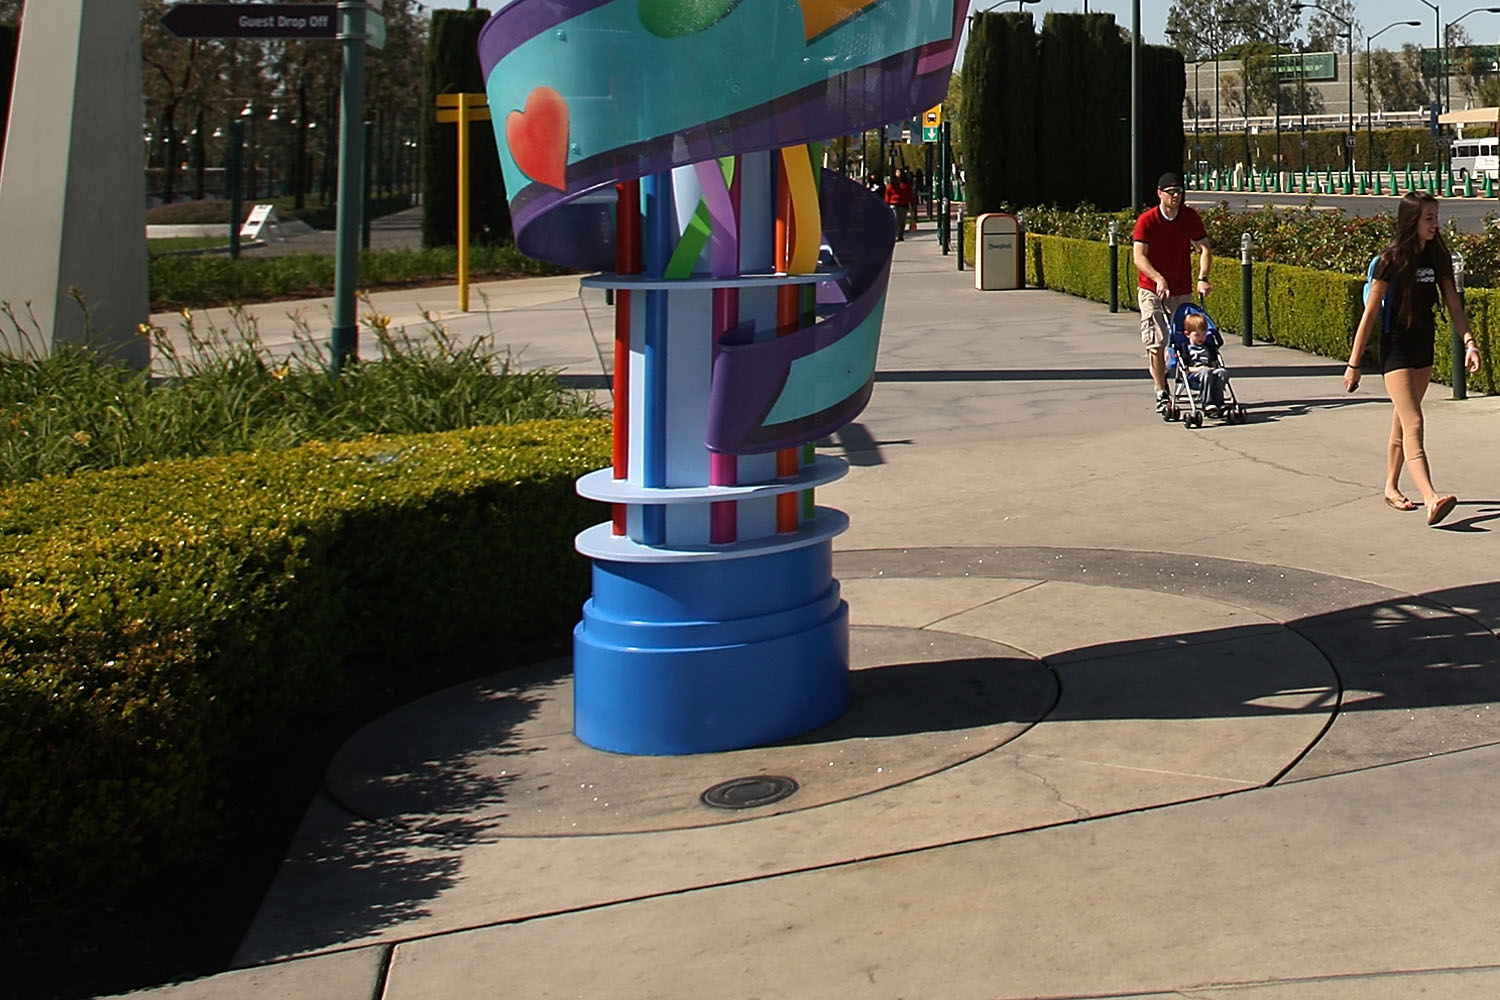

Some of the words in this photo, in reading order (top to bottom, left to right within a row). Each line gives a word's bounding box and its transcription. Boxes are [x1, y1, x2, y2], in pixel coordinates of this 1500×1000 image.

[239, 15, 274, 27] Guest
[277, 15, 306, 29] Drop
[309, 15, 328, 27] Off
